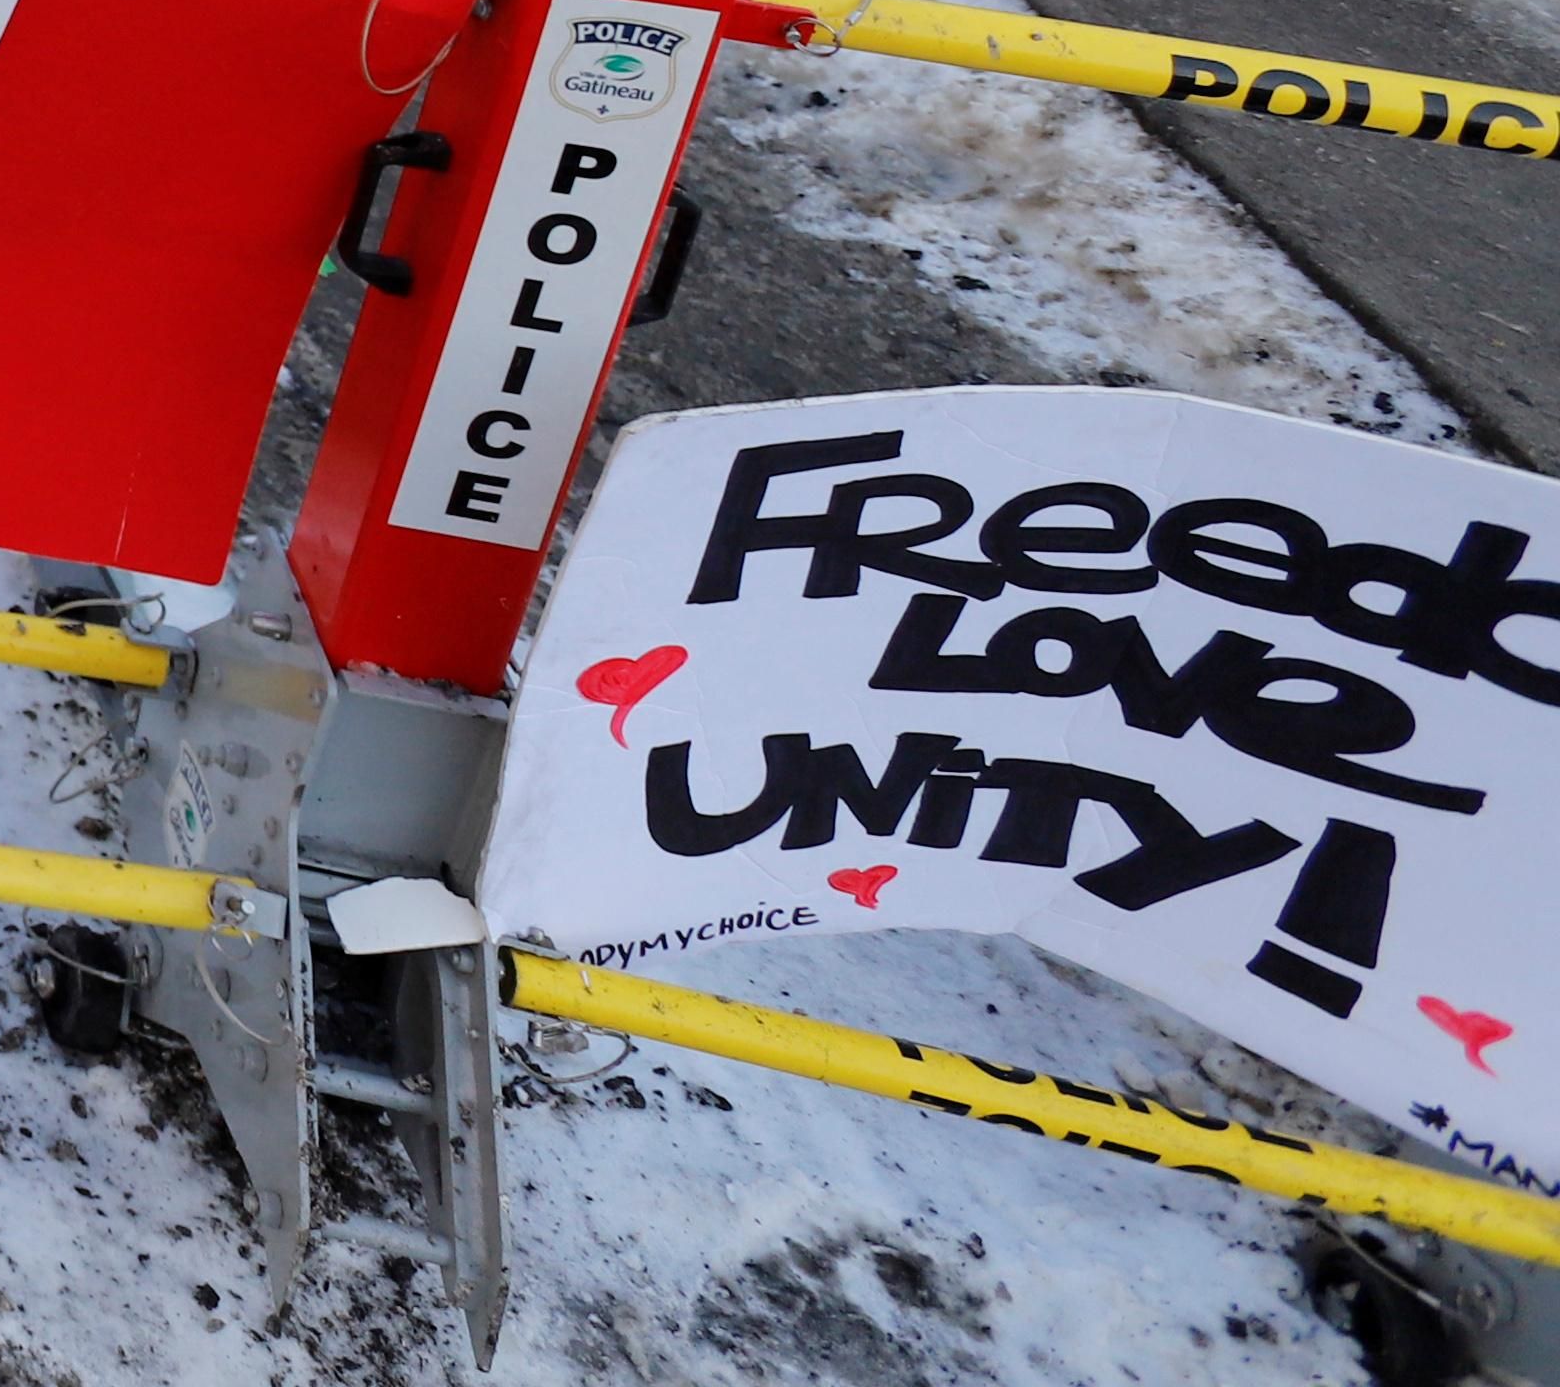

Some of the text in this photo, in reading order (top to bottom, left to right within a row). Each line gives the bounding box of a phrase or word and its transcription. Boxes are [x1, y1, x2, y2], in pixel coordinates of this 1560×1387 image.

[576, 23, 680, 55] POLICE
[563, 75, 656, 103] Gatineau
[1162, 53, 1560, 160] POLIC
[445, 141, 619, 524] POLICE
